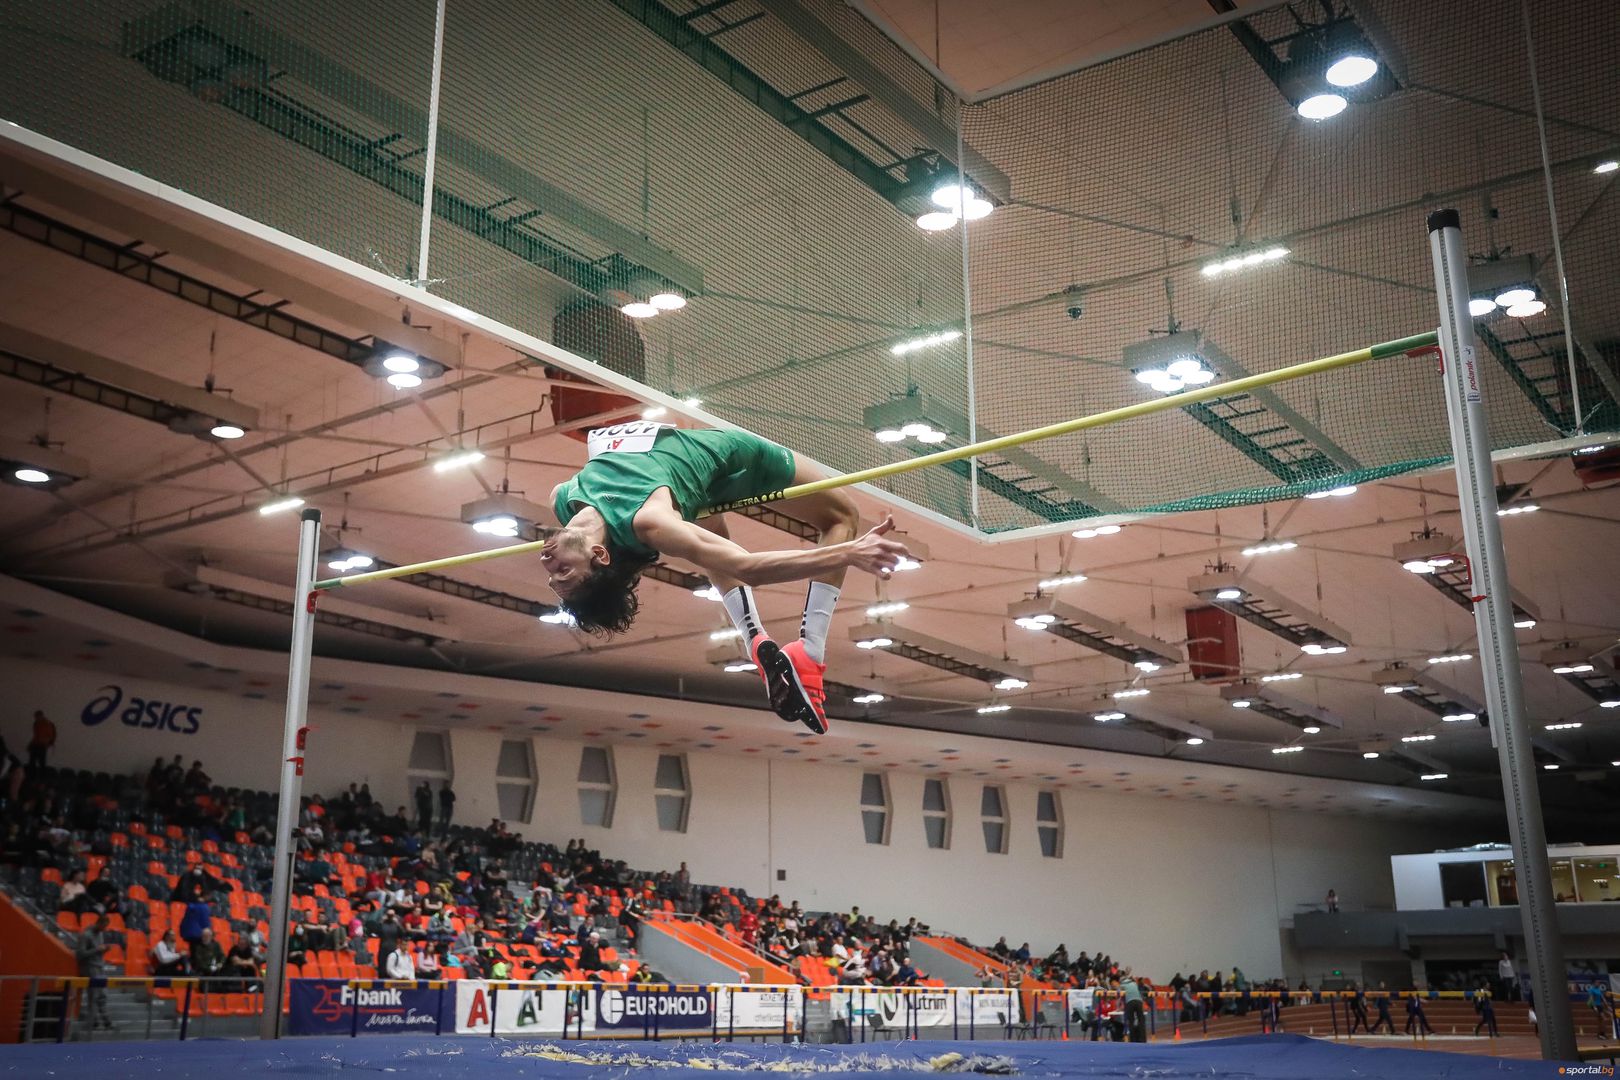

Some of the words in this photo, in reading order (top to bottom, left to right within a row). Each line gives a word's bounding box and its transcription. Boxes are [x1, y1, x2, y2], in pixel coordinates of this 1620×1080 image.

[121, 697, 203, 734] asics
[341, 985, 402, 1006] Fibank
[626, 996, 707, 1015] EUROHOLD
